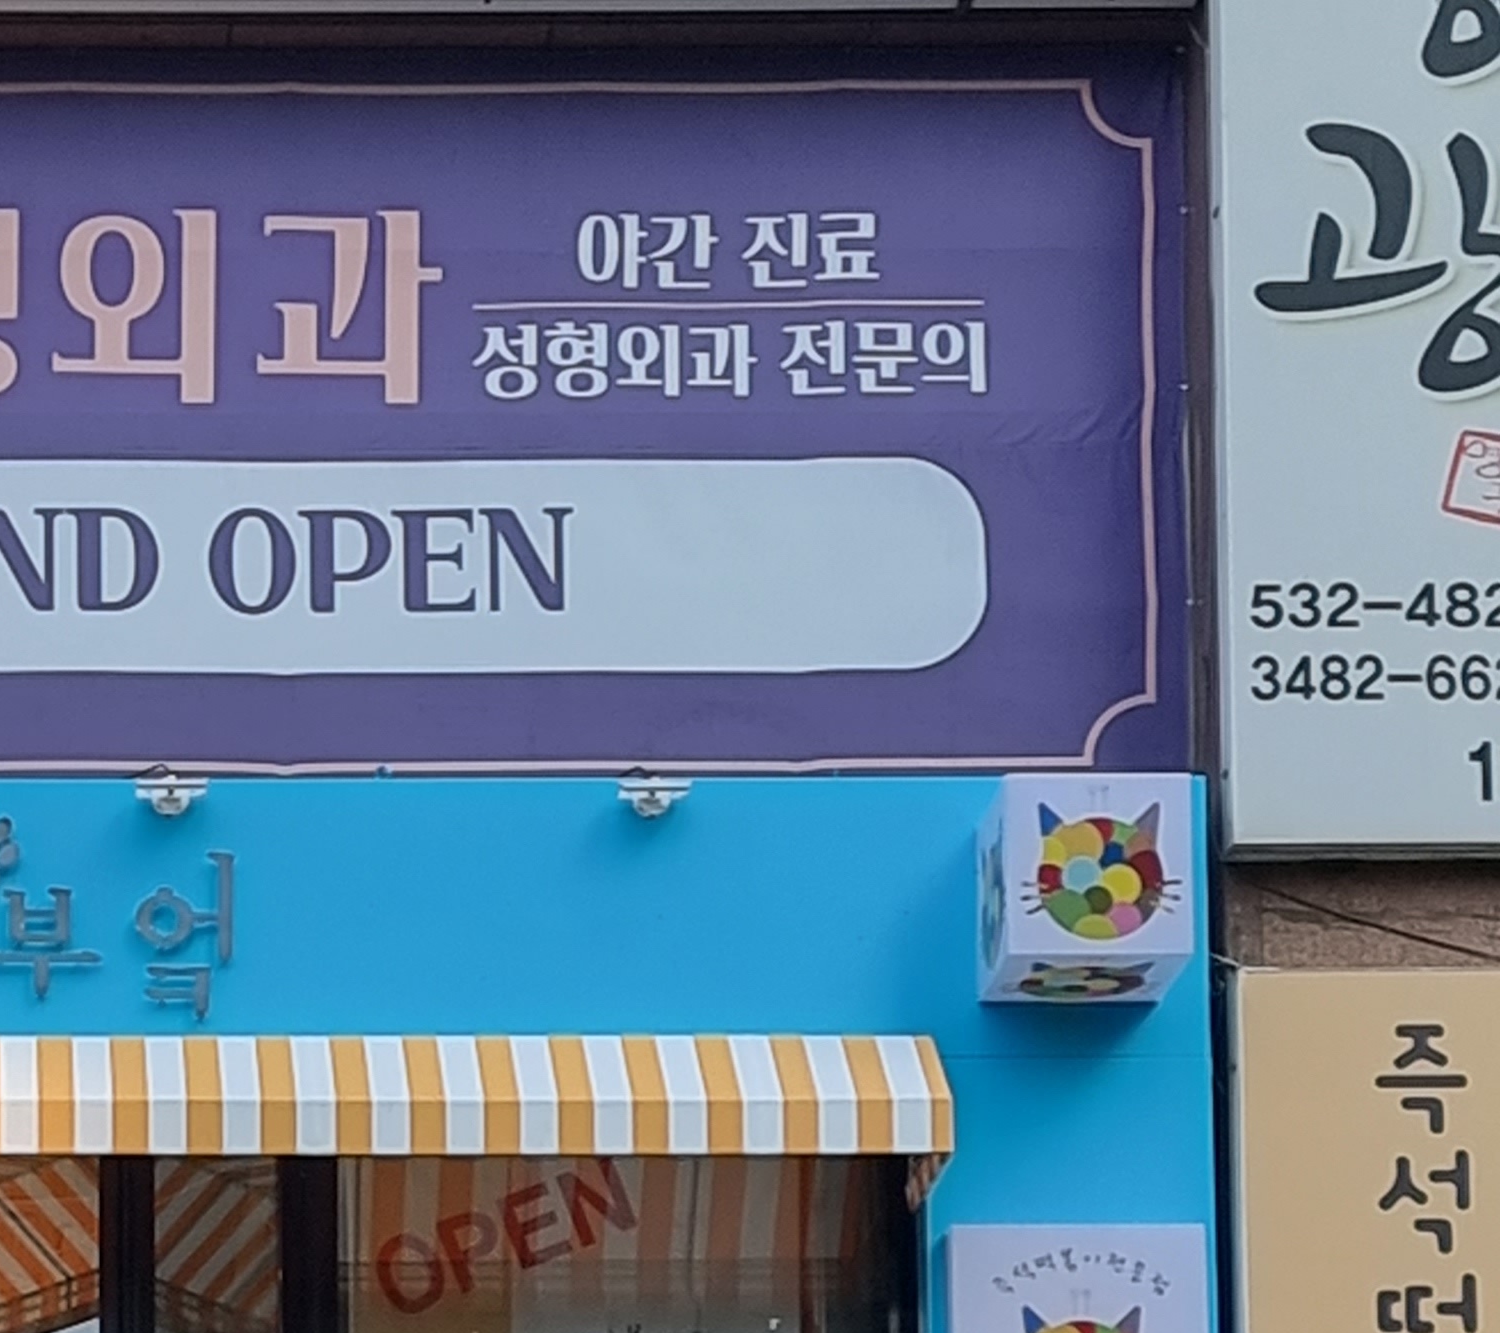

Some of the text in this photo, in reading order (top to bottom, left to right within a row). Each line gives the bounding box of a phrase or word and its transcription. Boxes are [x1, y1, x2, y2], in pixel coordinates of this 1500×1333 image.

[577, 211, 882, 290] 야간 진료
[472, 320, 990, 400] 성형외과 전문의
[206, 504, 574, 614] OPEN
[1251, 654, 1500, 701] 3482-66
[374, 1156, 639, 1315] OPEN
